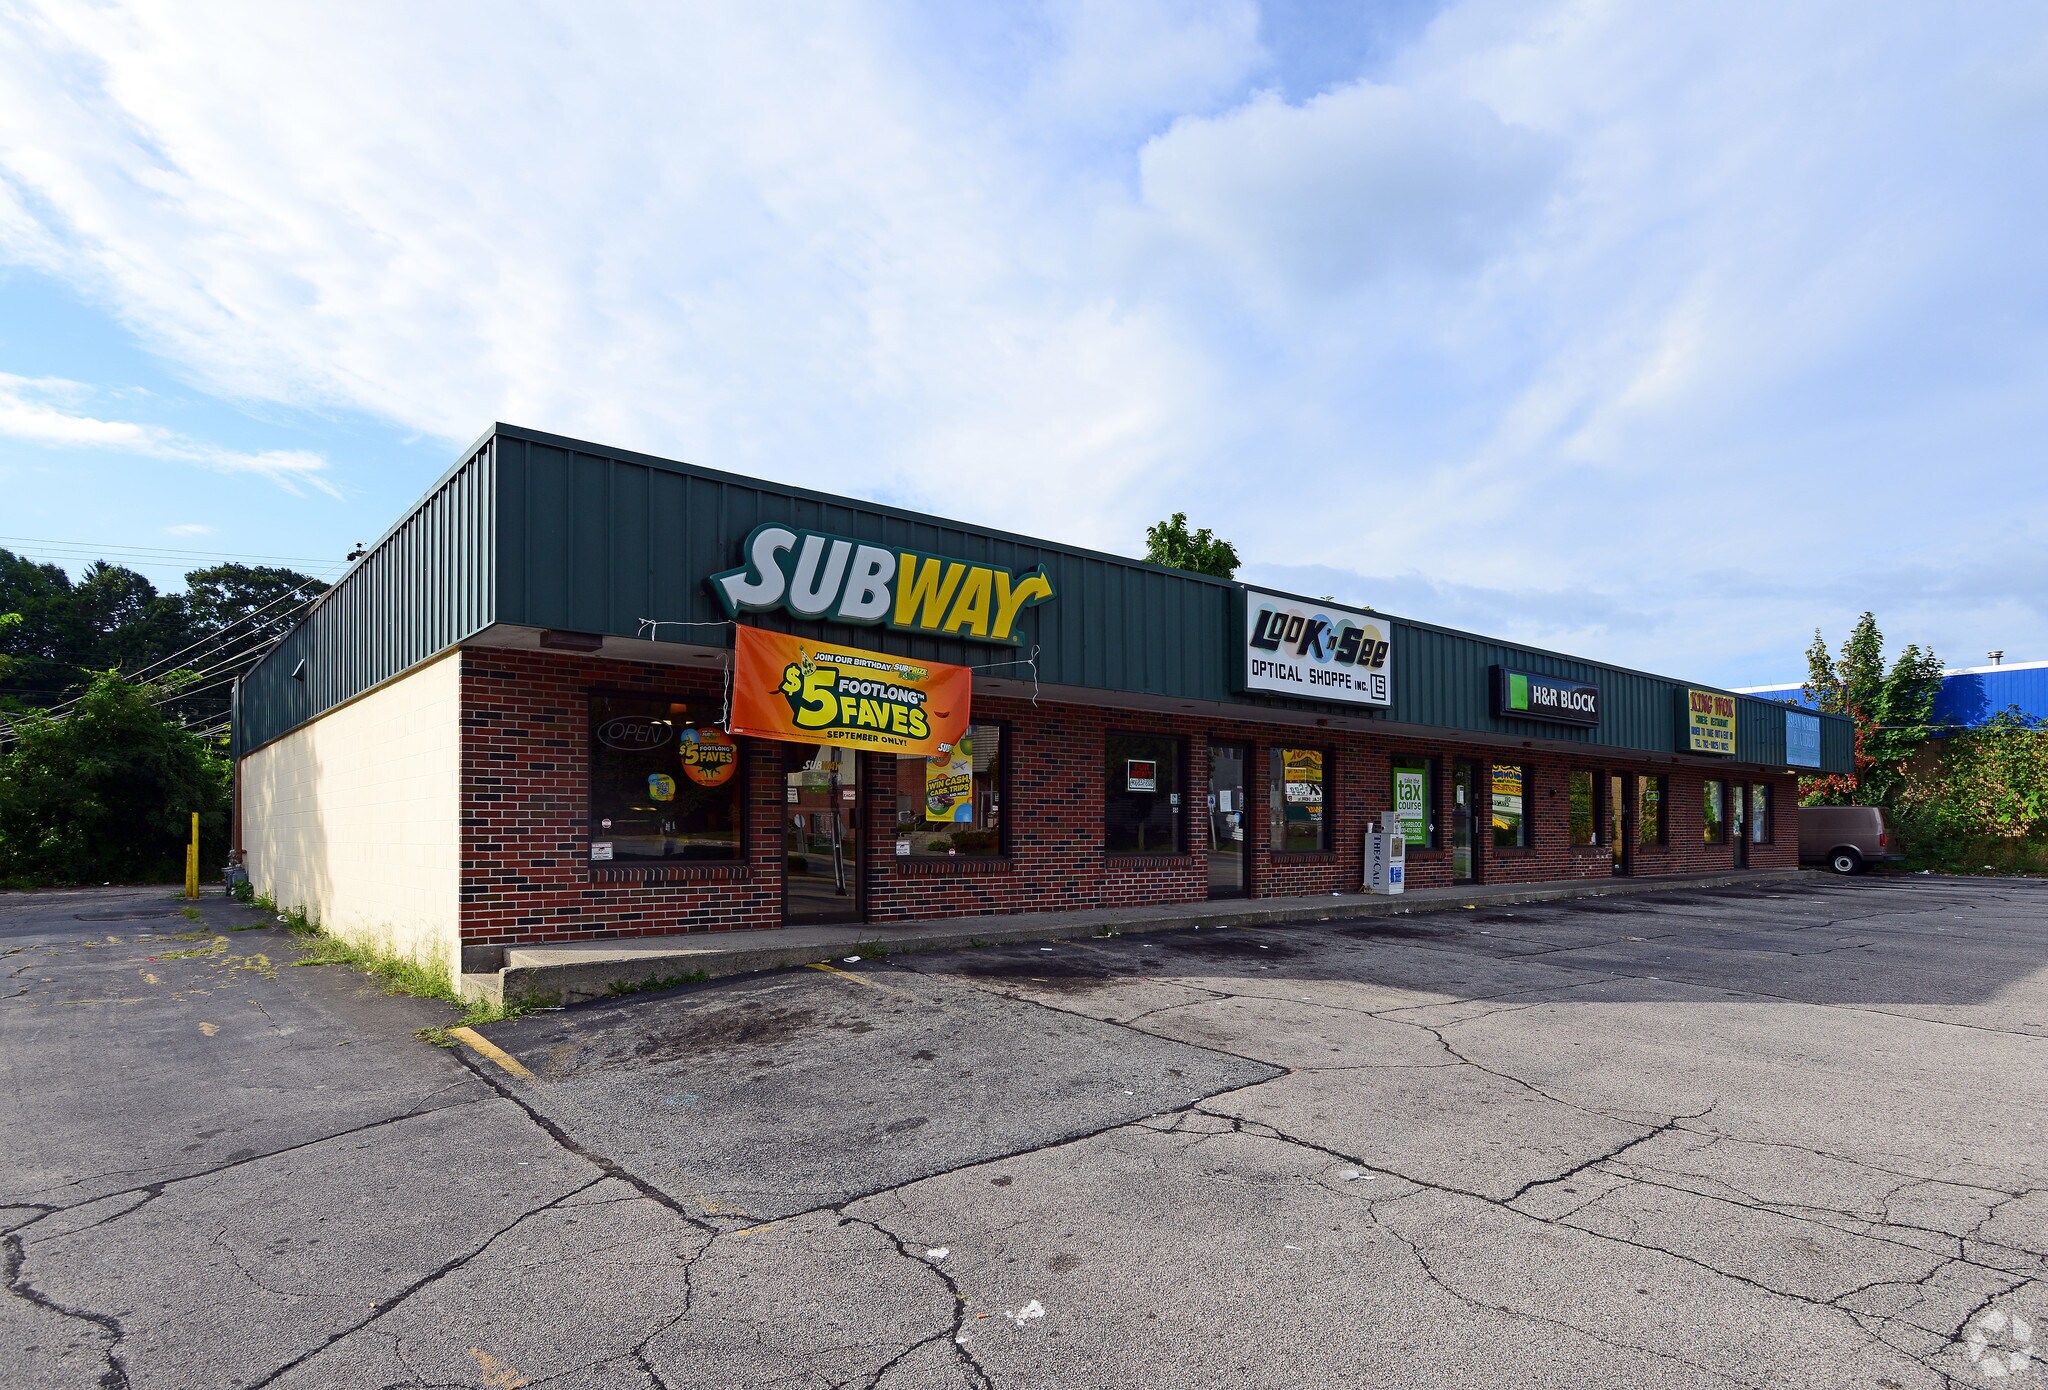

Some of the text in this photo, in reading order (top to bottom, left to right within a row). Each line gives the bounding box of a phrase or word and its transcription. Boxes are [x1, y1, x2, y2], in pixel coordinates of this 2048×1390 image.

[720, 527, 1053, 639] SUBWAY
[814, 652, 834, 662] JOIN
[835, 655, 853, 665] OUR
[853, 658, 892, 671] BIRTHDAY
[1252, 659, 1368, 692] OPTICAL SHOPPE INC.
[1533, 685, 1595, 713] H&R BLOCK
[1690, 692, 1733, 718] KING WOK
[840, 696, 928, 737] FAVES
[608, 722, 662, 743] OPEN
[827, 730, 879, 743] SEPTEMBER
[881, 736, 907, 747] ONLY!
[679, 744, 699, 765] $5
[700, 752, 733, 763] FAVES
[803, 760, 843, 771] SUBWAY
[928, 780, 945, 790] WIN
[1398, 780, 1421, 800] tax
[1398, 801, 1422, 810] course
[1373, 862, 1381, 887] CALL
